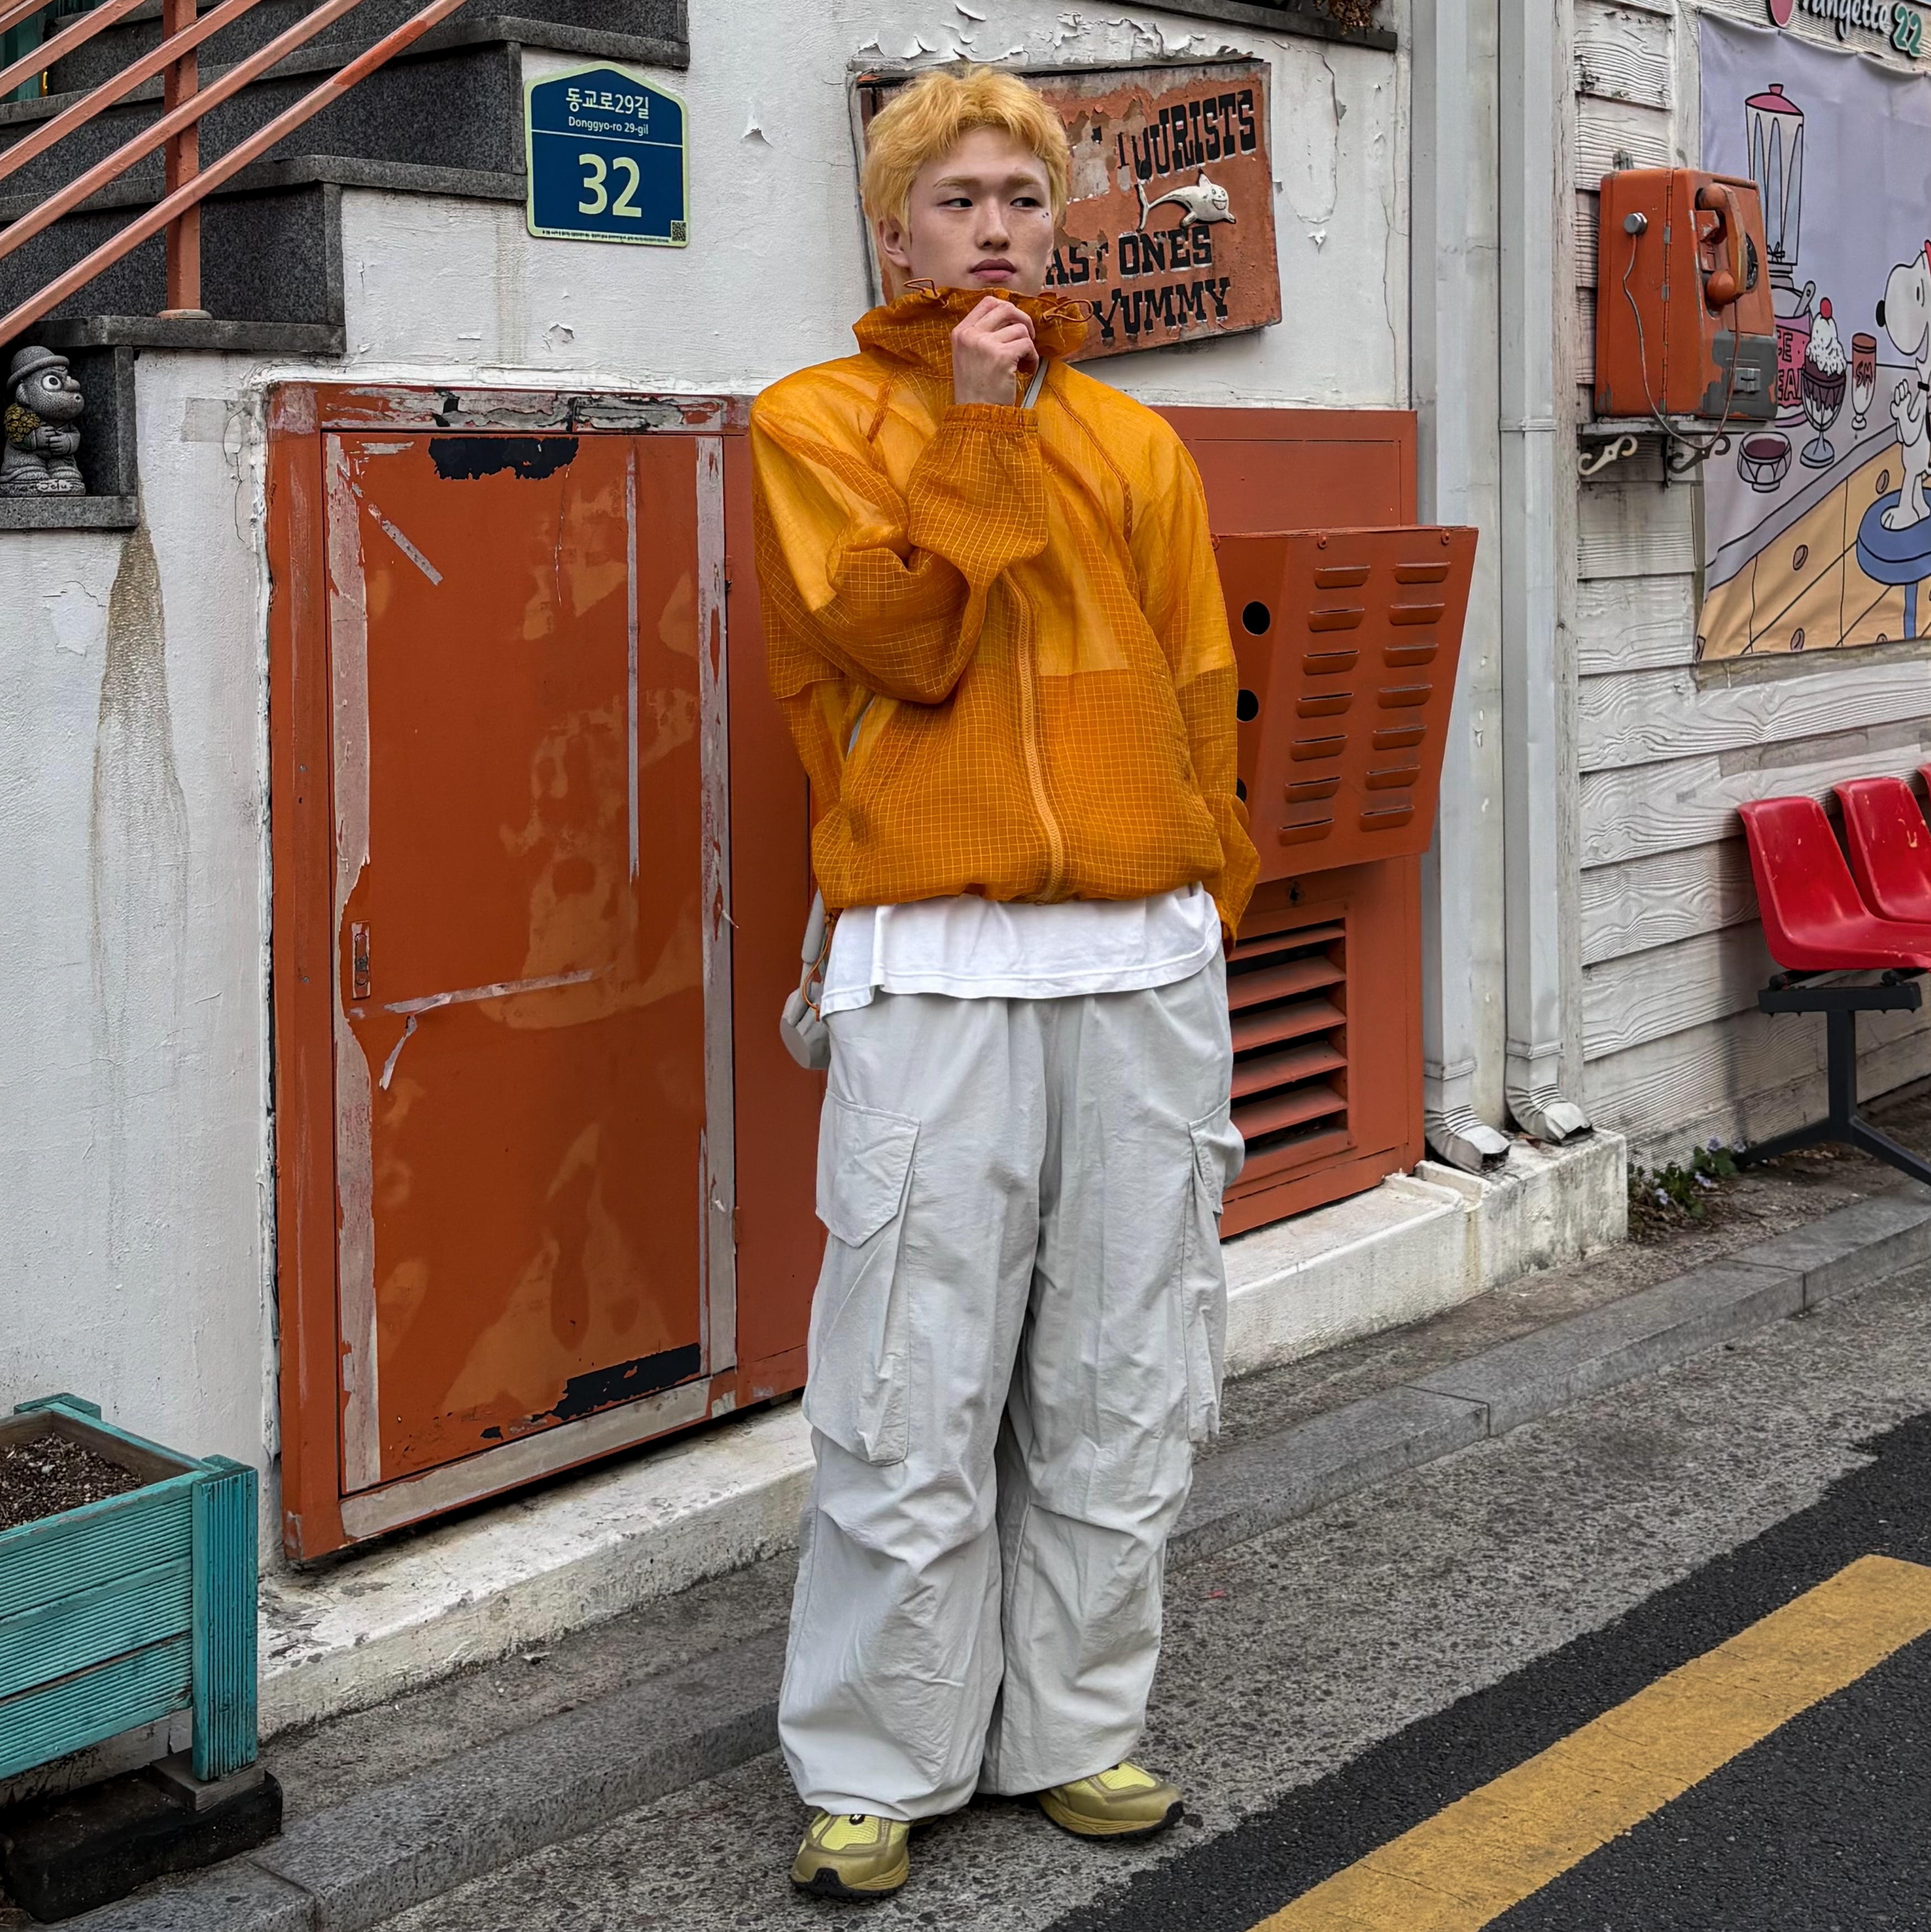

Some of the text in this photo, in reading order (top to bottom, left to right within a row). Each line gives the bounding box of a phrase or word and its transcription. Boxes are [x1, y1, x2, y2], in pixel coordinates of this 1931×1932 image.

[1893, 2, 1922, 56] 22
[565, 87, 649, 119] 동교로29길
[568, 116, 649, 137] Donggyo-ro 29-gil
[579, 153, 642, 217] 32
[1118, 225, 1212, 279] ONES
[1089, 277, 1231, 339] YUMMY
